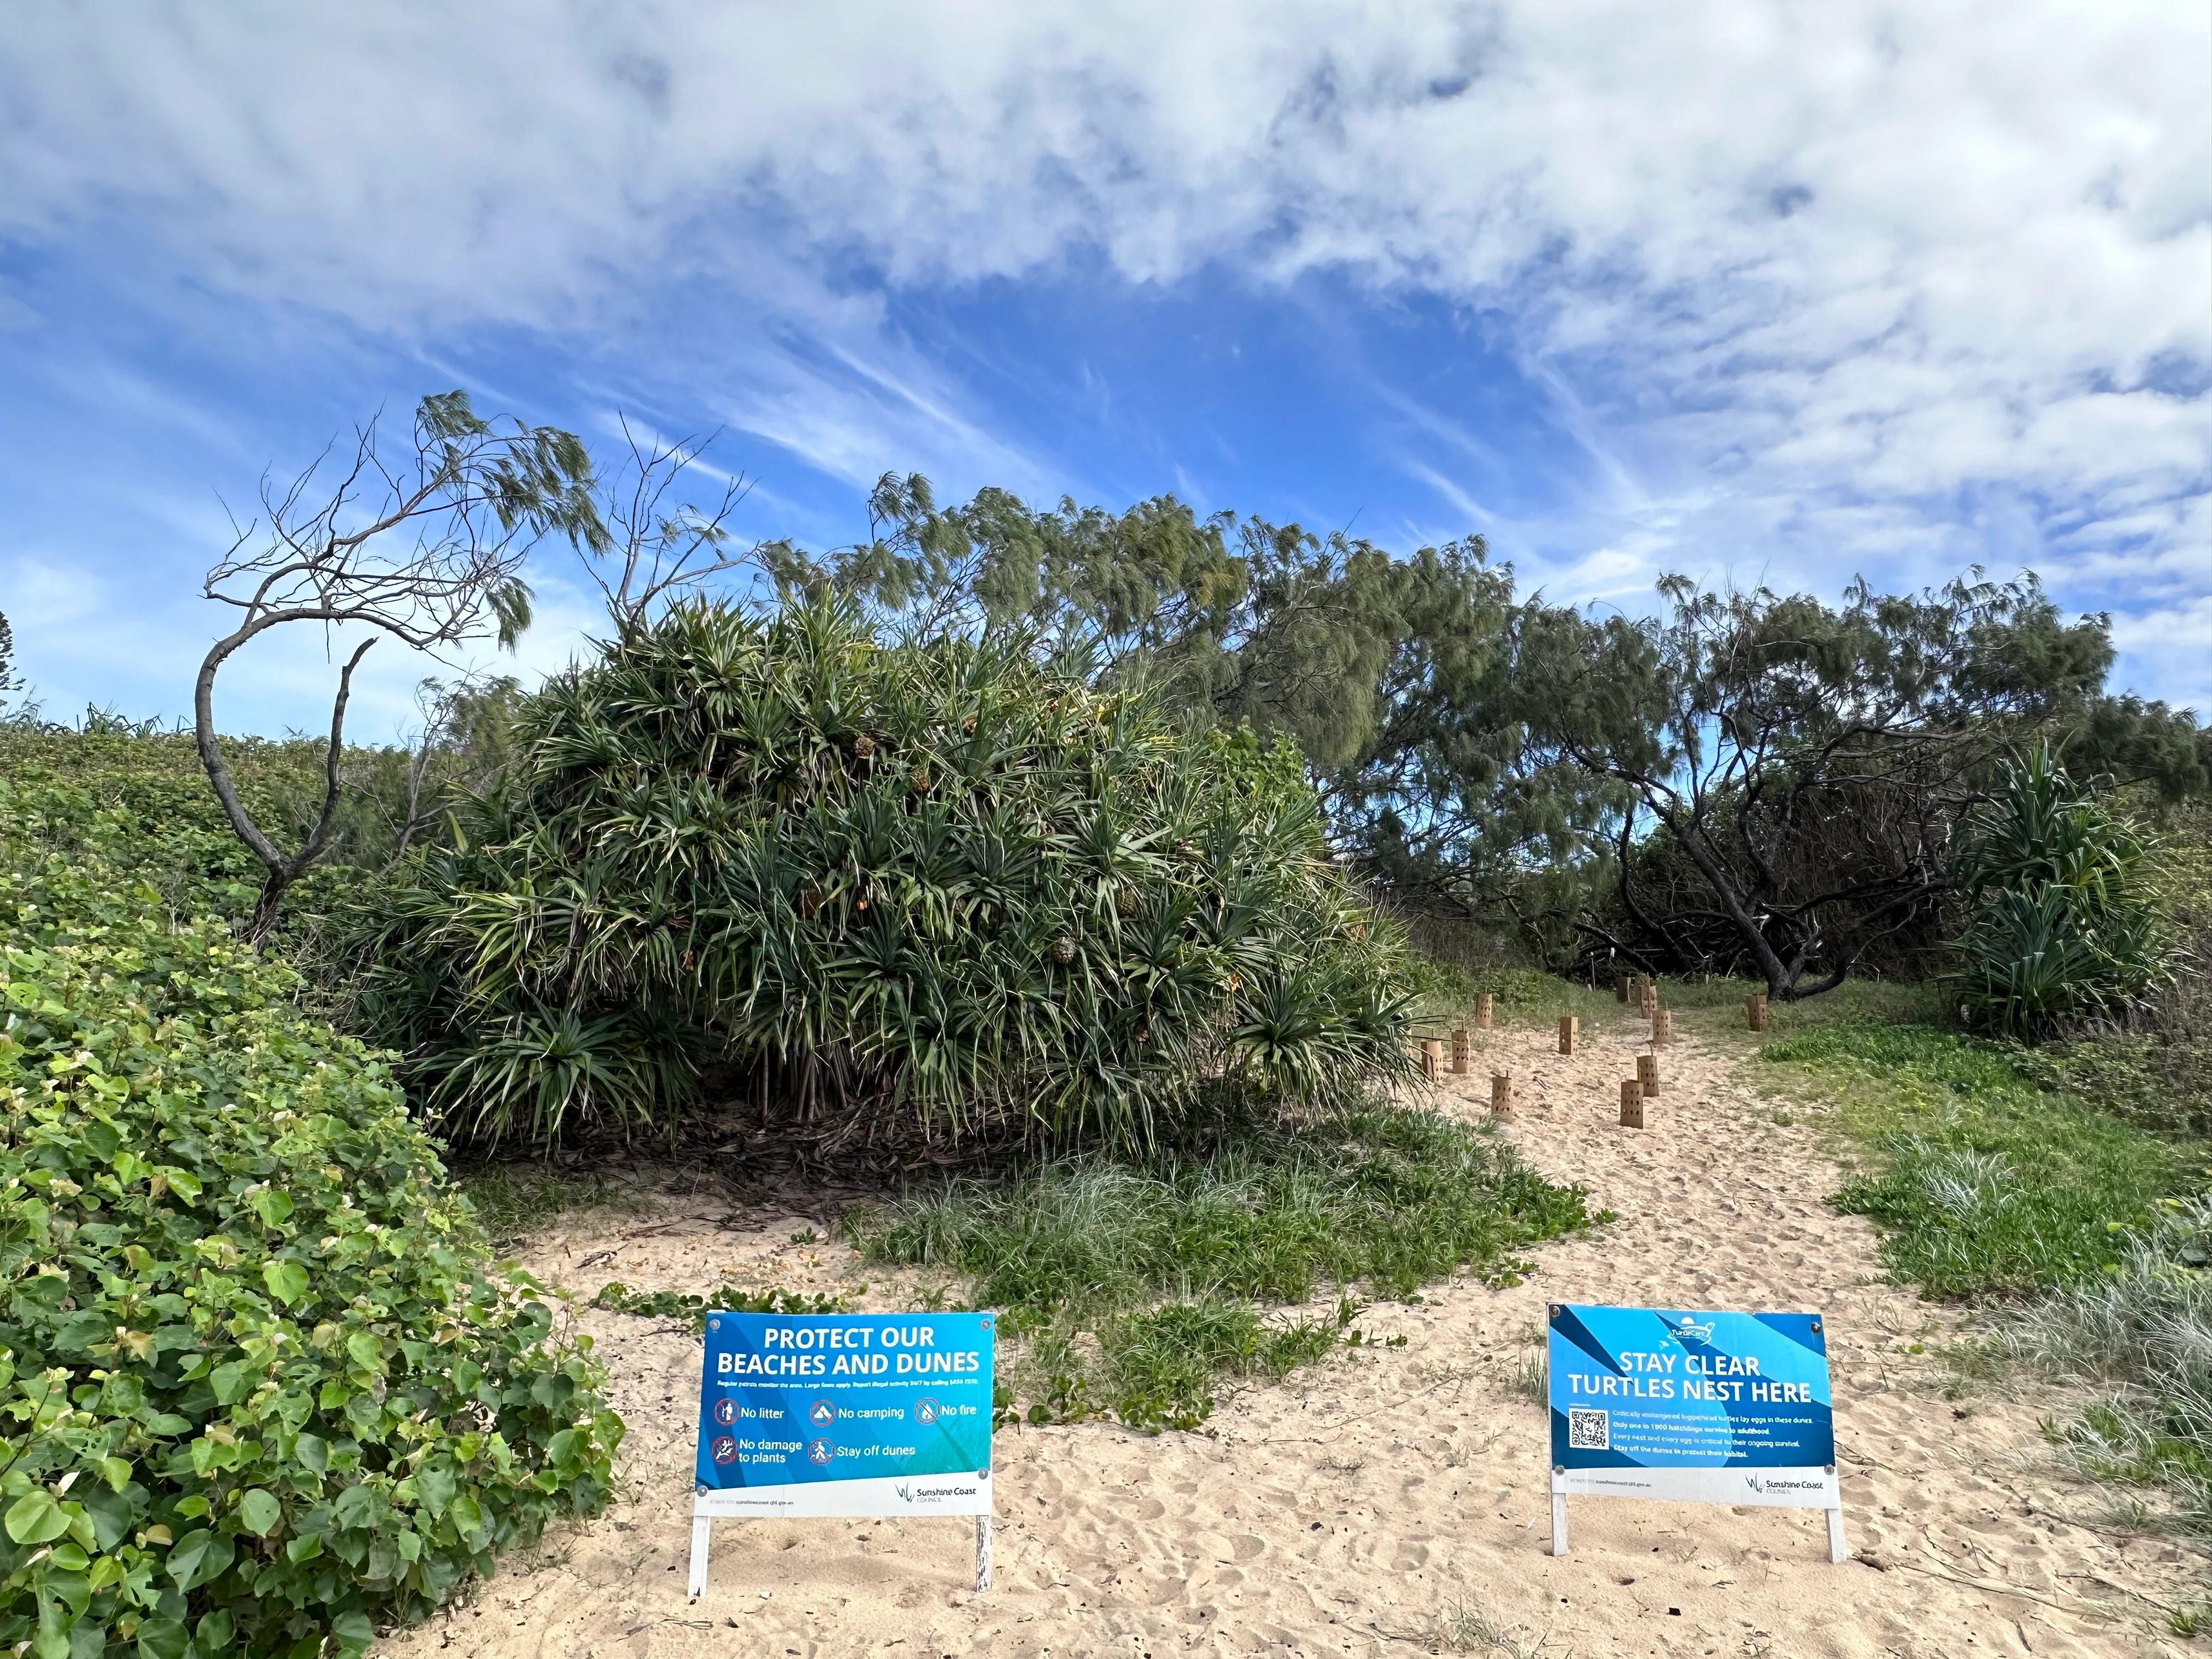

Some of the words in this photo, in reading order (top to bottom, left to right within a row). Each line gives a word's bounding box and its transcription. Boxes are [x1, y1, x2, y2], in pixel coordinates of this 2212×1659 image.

[765, 1328, 874, 1349] PROTECT
[881, 1327, 934, 1347] OUR
[718, 1353, 825, 1375] BEACHES
[832, 1354, 888, 1374] AND
[896, 1351, 979, 1373] DUNES
[1620, 1352, 1677, 1373] STAY
[1685, 1355, 1760, 1376] CLEAR
[1567, 1374, 1675, 1398] TURTLES
[1683, 1380, 1744, 1401] NEST
[1752, 1382, 1812, 1403] HERE
[741, 1407, 756, 1418] No
[759, 1408, 784, 1419] litter
[839, 1408, 854, 1418] No
[857, 1407, 905, 1420] camping
[941, 1406, 957, 1415] No
[960, 1404, 977, 1415] fire
[740, 1438, 755, 1449] No
[758, 1439, 803, 1453] damage
[837, 1446, 861, 1458] Stay
[864, 1445, 879, 1455] off
[882, 1445, 915, 1455] dunes
[738, 1453, 749, 1463] to
[753, 1452, 786, 1464] plants
[1766, 1480, 1800, 1488] Sunshine
[917, 1488, 953, 1497] Sunshine
